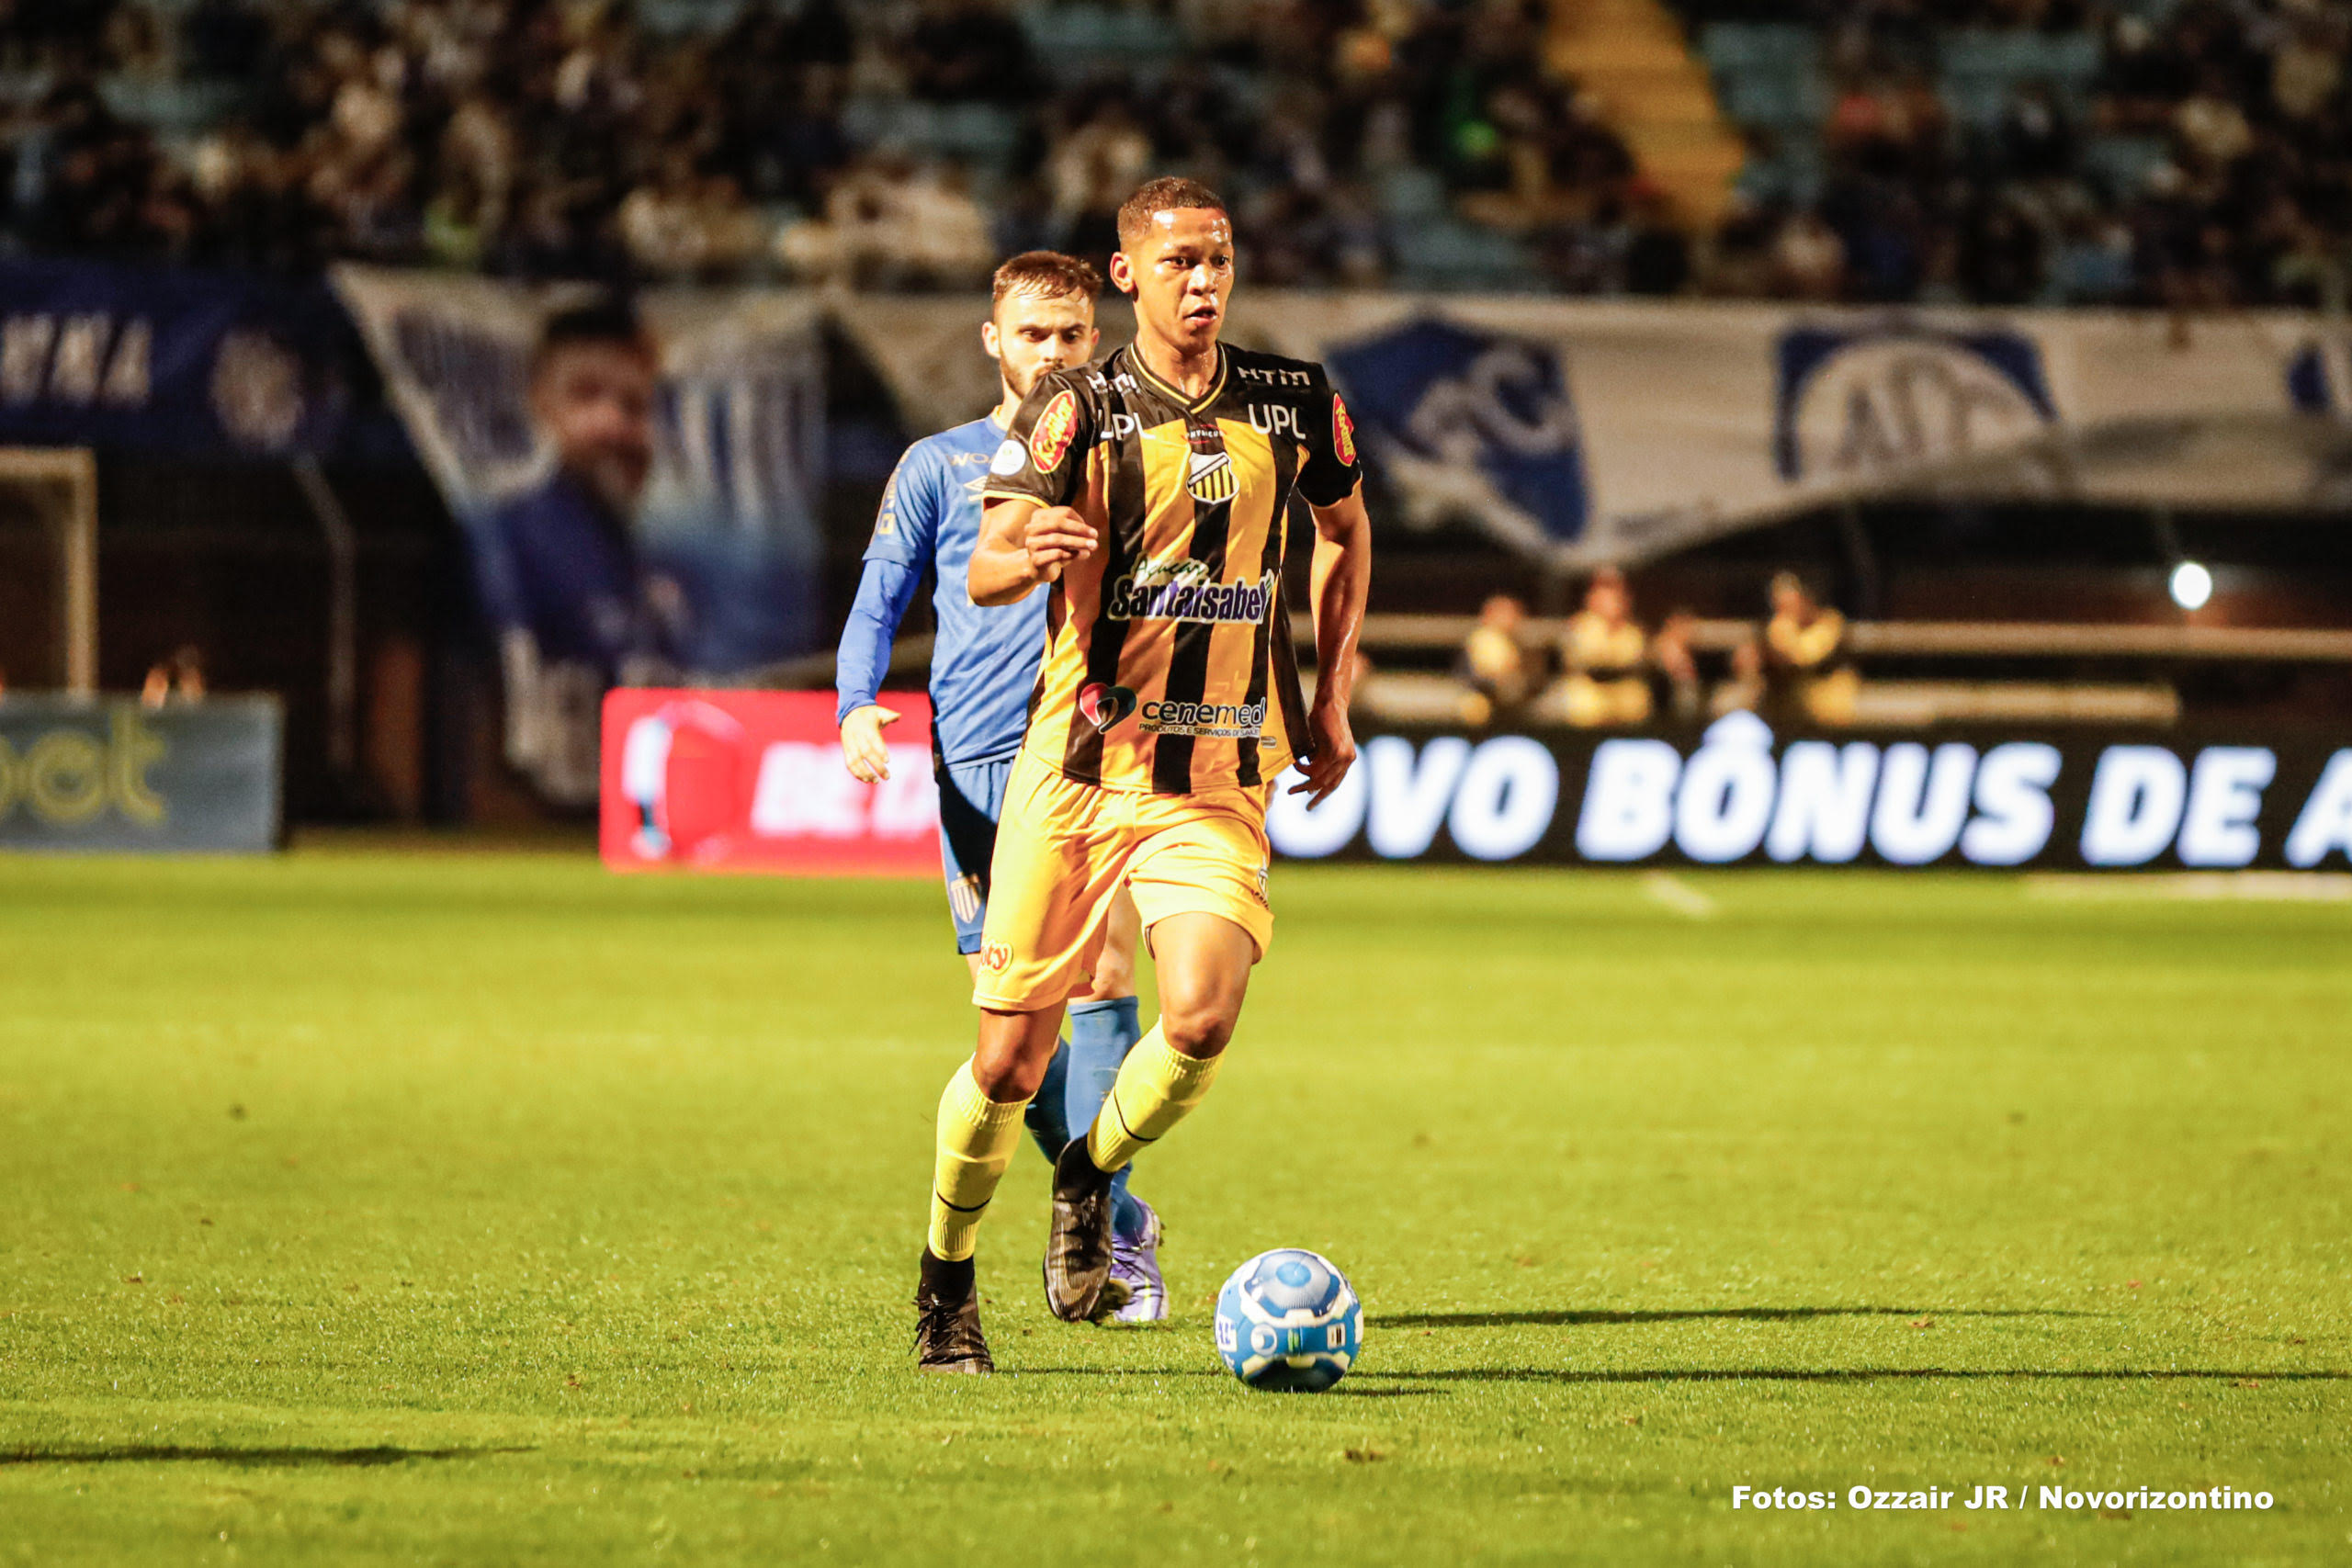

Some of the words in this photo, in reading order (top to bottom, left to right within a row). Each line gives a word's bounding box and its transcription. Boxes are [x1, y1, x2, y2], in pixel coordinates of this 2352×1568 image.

[1237, 367, 1311, 387] HTM
[1248, 404, 1306, 440] UPL
[1142, 697, 1266, 726] cenemed
[1139, 723, 1185, 734] PRODUTOS
[1186, 726, 1193, 734] E
[1576, 709, 2063, 866] BÔNUS
[2079, 745, 2277, 868] DE
